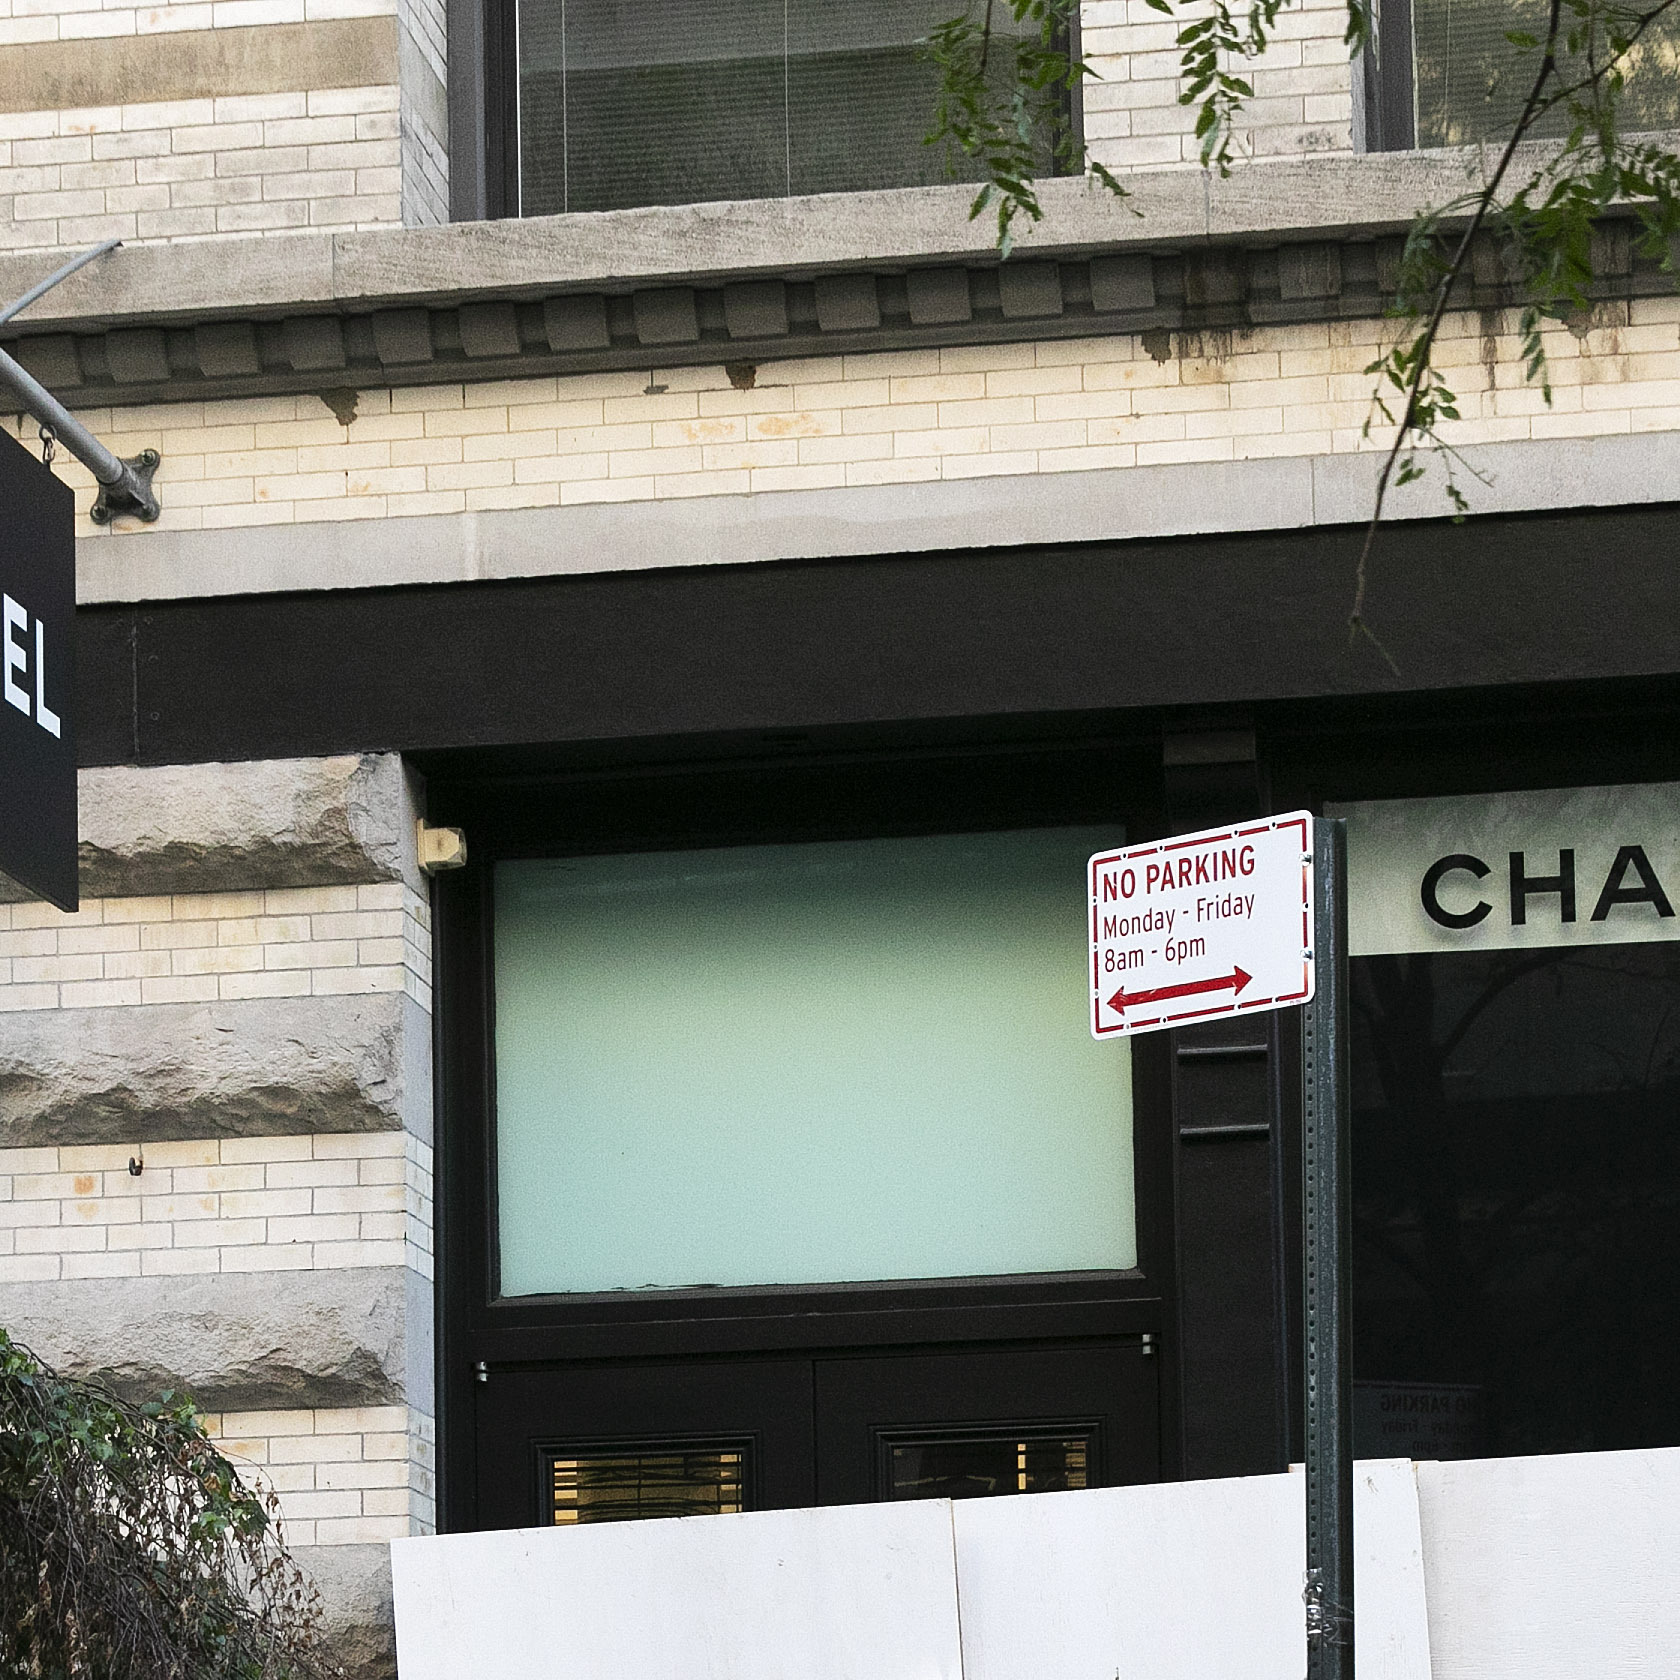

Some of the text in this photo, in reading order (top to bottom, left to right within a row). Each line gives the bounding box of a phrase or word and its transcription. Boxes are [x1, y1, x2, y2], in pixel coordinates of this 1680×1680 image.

[1103, 845, 1255, 903] NO PARKING
[1104, 907, 1176, 940] Monday
[1197, 893, 1255, 923] Friday
[1105, 948, 1144, 973] 8am
[1165, 936, 1205, 966] 6pm
